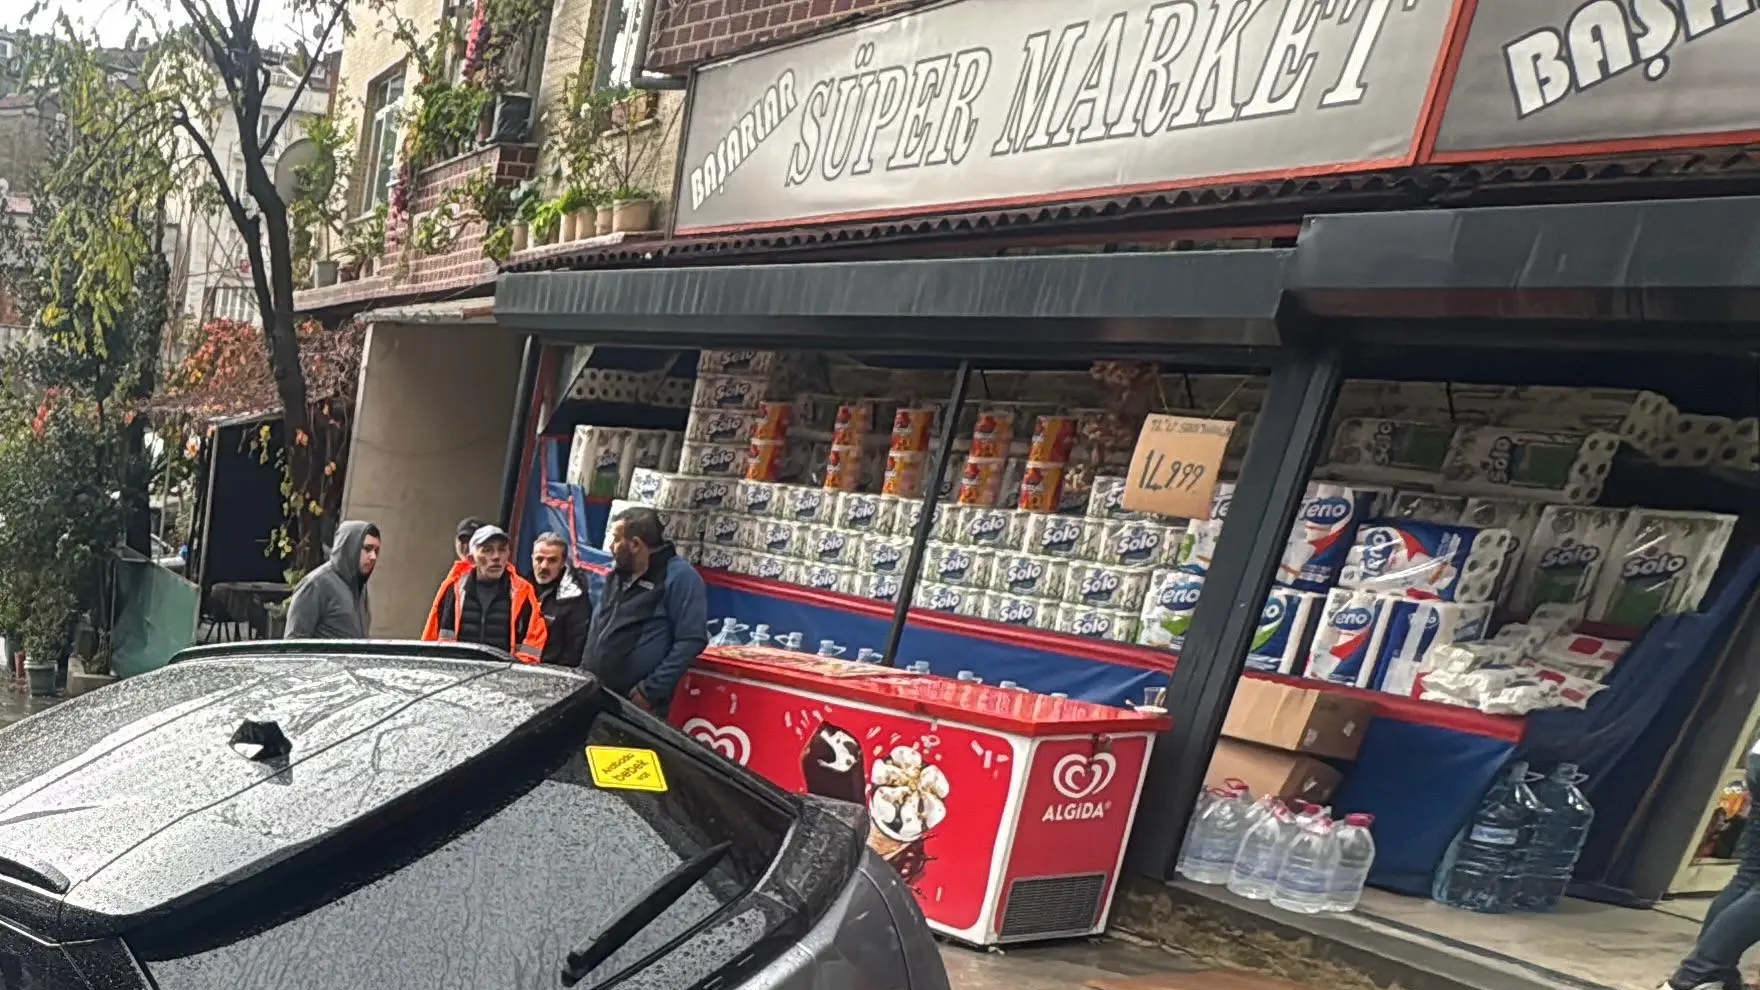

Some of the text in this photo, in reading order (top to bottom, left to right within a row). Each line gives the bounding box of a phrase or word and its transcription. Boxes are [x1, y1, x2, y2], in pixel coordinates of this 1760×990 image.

[783, 0, 1418, 188] SÜPER MARKET
[694, 483, 728, 500] Solo
[747, 487, 773, 504] Solo
[794, 496, 820, 512] Solo
[847, 502, 876, 520] Solo
[1299, 497, 1346, 521] Teno
[970, 515, 1005, 537] Solo
[1041, 524, 1081, 546] Solo
[766, 527, 791, 544] Solo
[817, 536, 844, 552] Solo
[1117, 530, 1159, 553] Solo
[938, 555, 970, 573] Solo
[1540, 545, 1600, 568] Solo
[1621, 554, 1687, 577] Solo
[809, 573, 837, 589] Solo
[1006, 563, 1042, 583] Solo
[868, 582, 897, 599] Solo
[1080, 573, 1119, 594] Solo
[928, 592, 960, 610] Solo
[999, 605, 1034, 623] Solo
[1070, 616, 1110, 636] Solo
